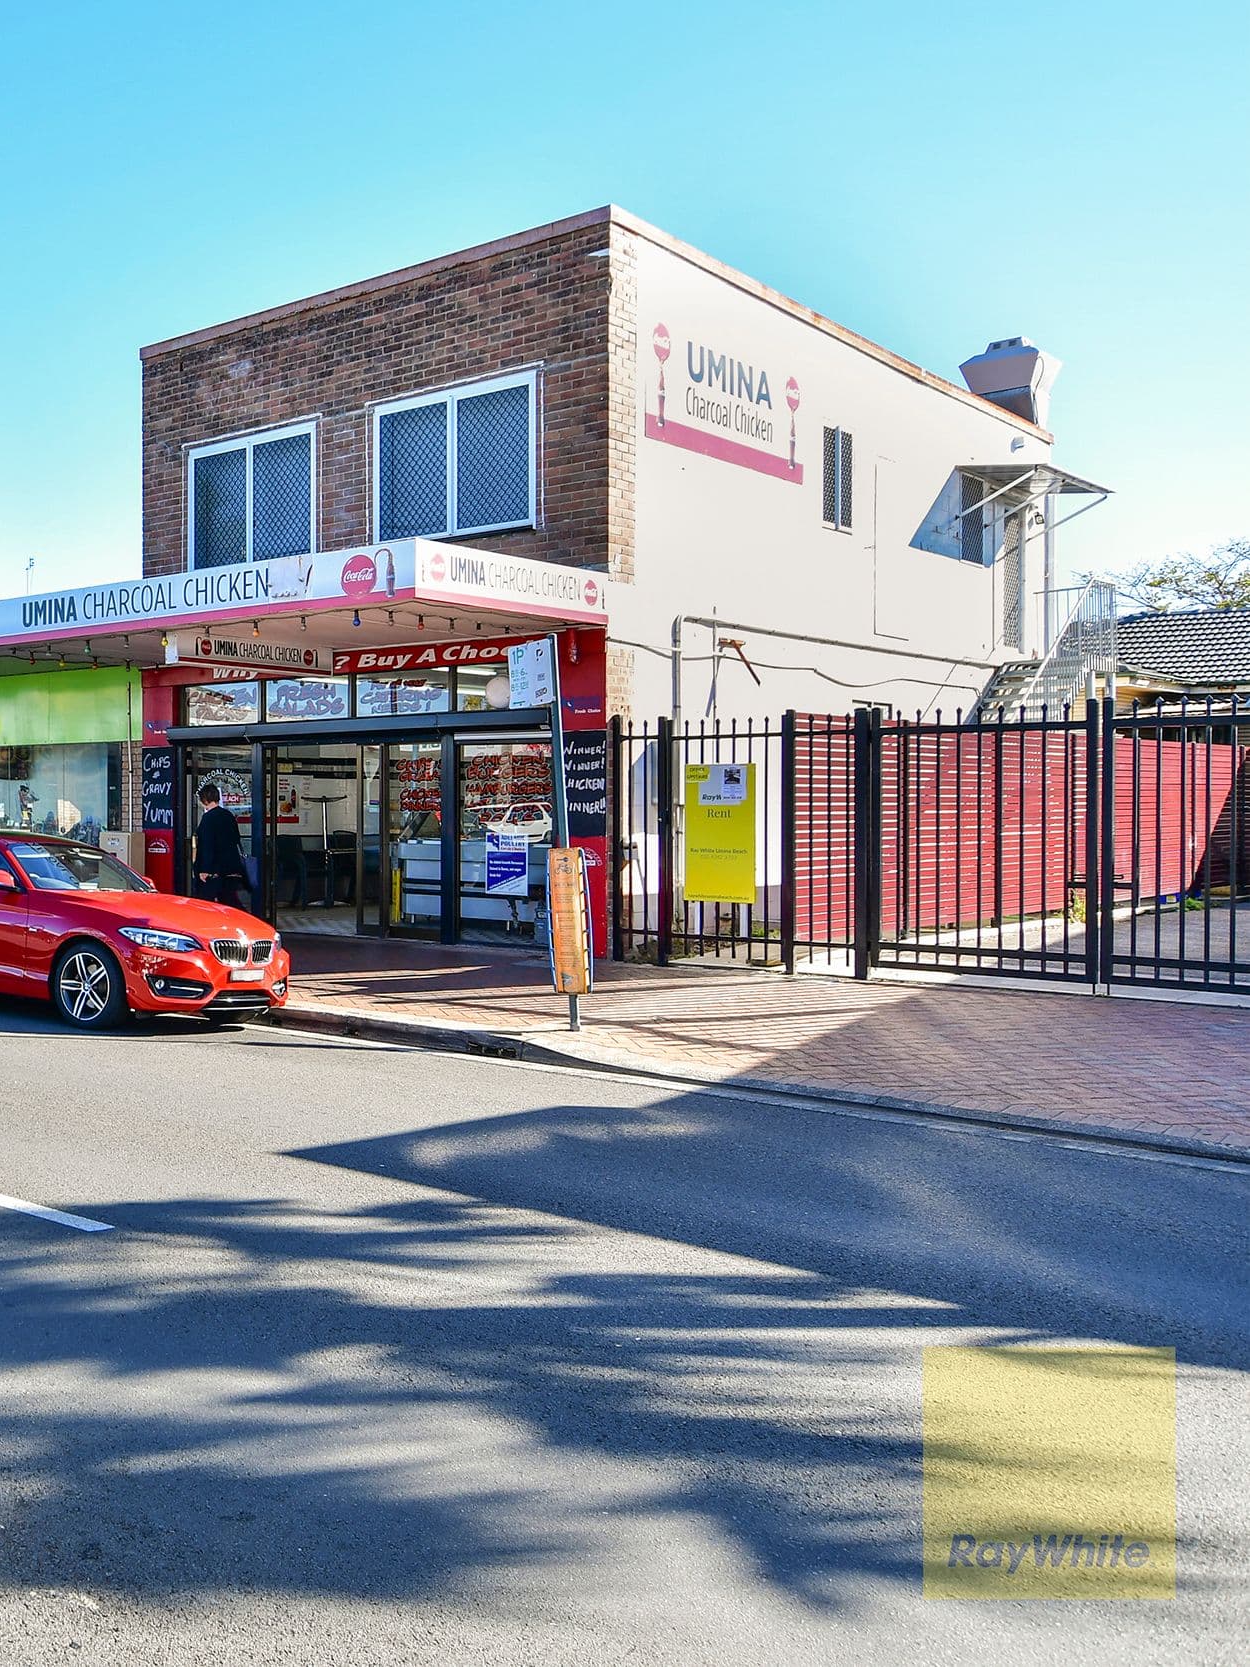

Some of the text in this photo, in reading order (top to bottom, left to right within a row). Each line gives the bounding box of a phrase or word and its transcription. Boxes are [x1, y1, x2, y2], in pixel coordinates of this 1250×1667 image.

[687, 340, 772, 410] UMINA
[686, 387, 773, 443] Charcoal Chicken
[450, 556, 581, 601] UMINA CHARCOAL CHICKEN
[23, 567, 269, 628] UMINA CHARCOAL CHICKEN
[214, 640, 239, 657] UMINA
[239, 642, 274, 661] CHARCOAL
[275, 646, 302, 663] CHICKEN
[357, 653, 413, 669] Buy
[416, 648, 437, 664] A
[512, 647, 525, 665] 1P
[471, 753, 546, 766] CHICKEN
[195, 768, 224, 797] CHARCOAL
[224, 768, 250, 796] CHICKEN
[466, 764, 551, 780] BURGERS
[465, 780, 553, 795] HAMBURGERS
[566, 777, 605, 791] HICKEN
[707, 808, 732, 818] Rent
